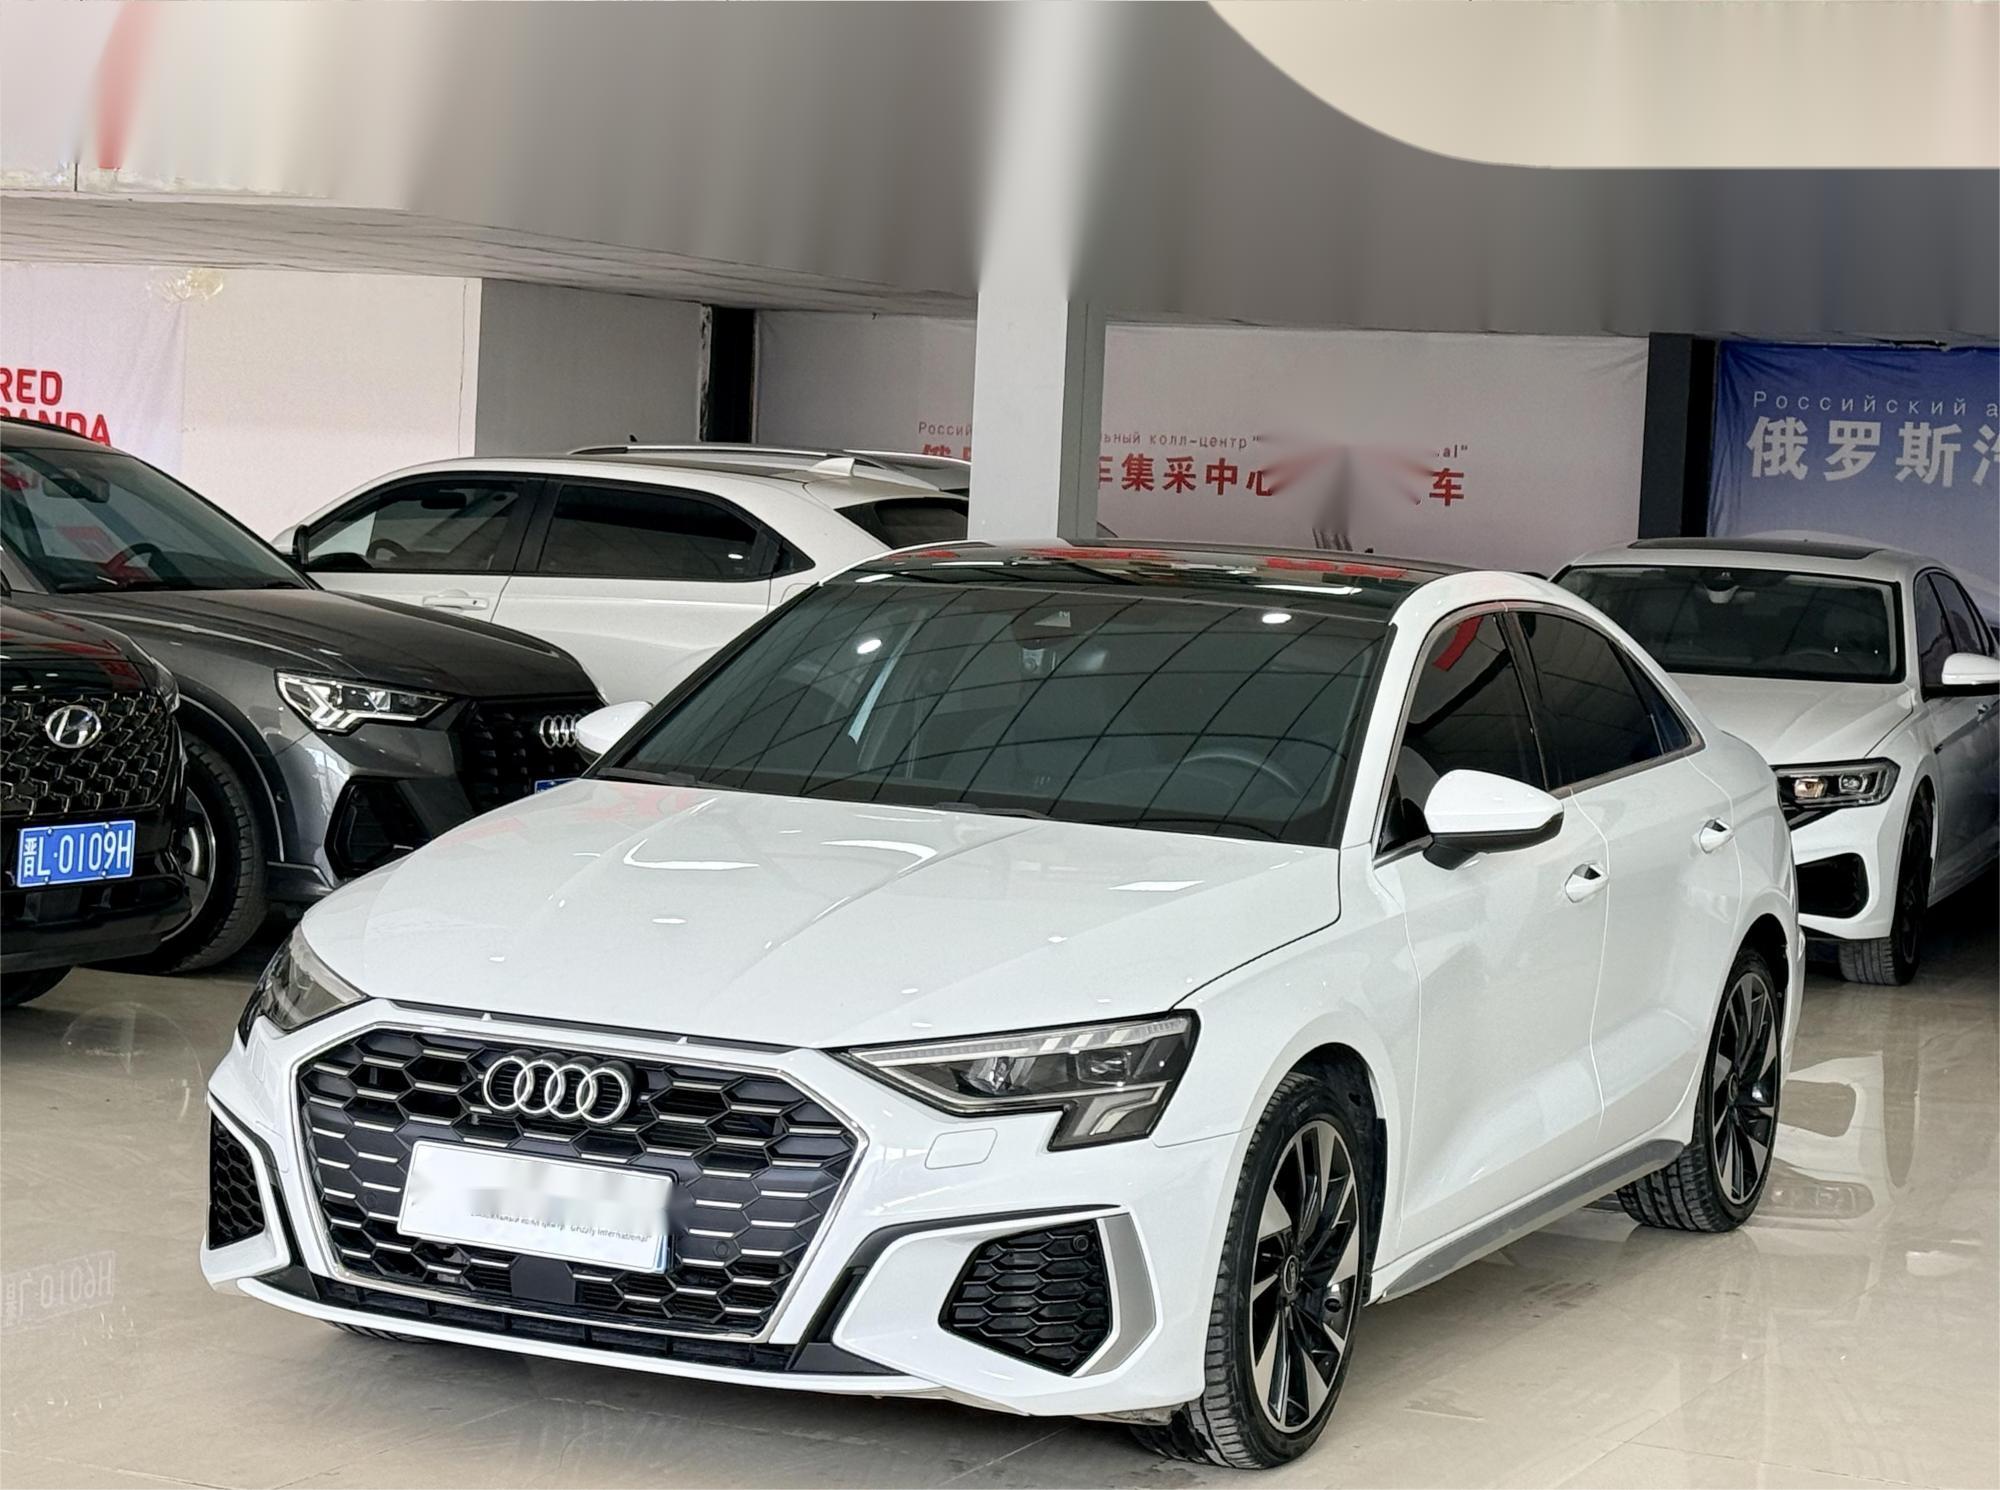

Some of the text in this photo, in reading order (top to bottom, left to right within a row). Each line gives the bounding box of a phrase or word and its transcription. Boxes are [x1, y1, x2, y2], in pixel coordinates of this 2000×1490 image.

[0, 367, 63, 406] RED
[1753, 391, 1967, 416] Российский
[1100, 431, 1141, 445] ьный
[1429, 467, 1465, 507] 车
